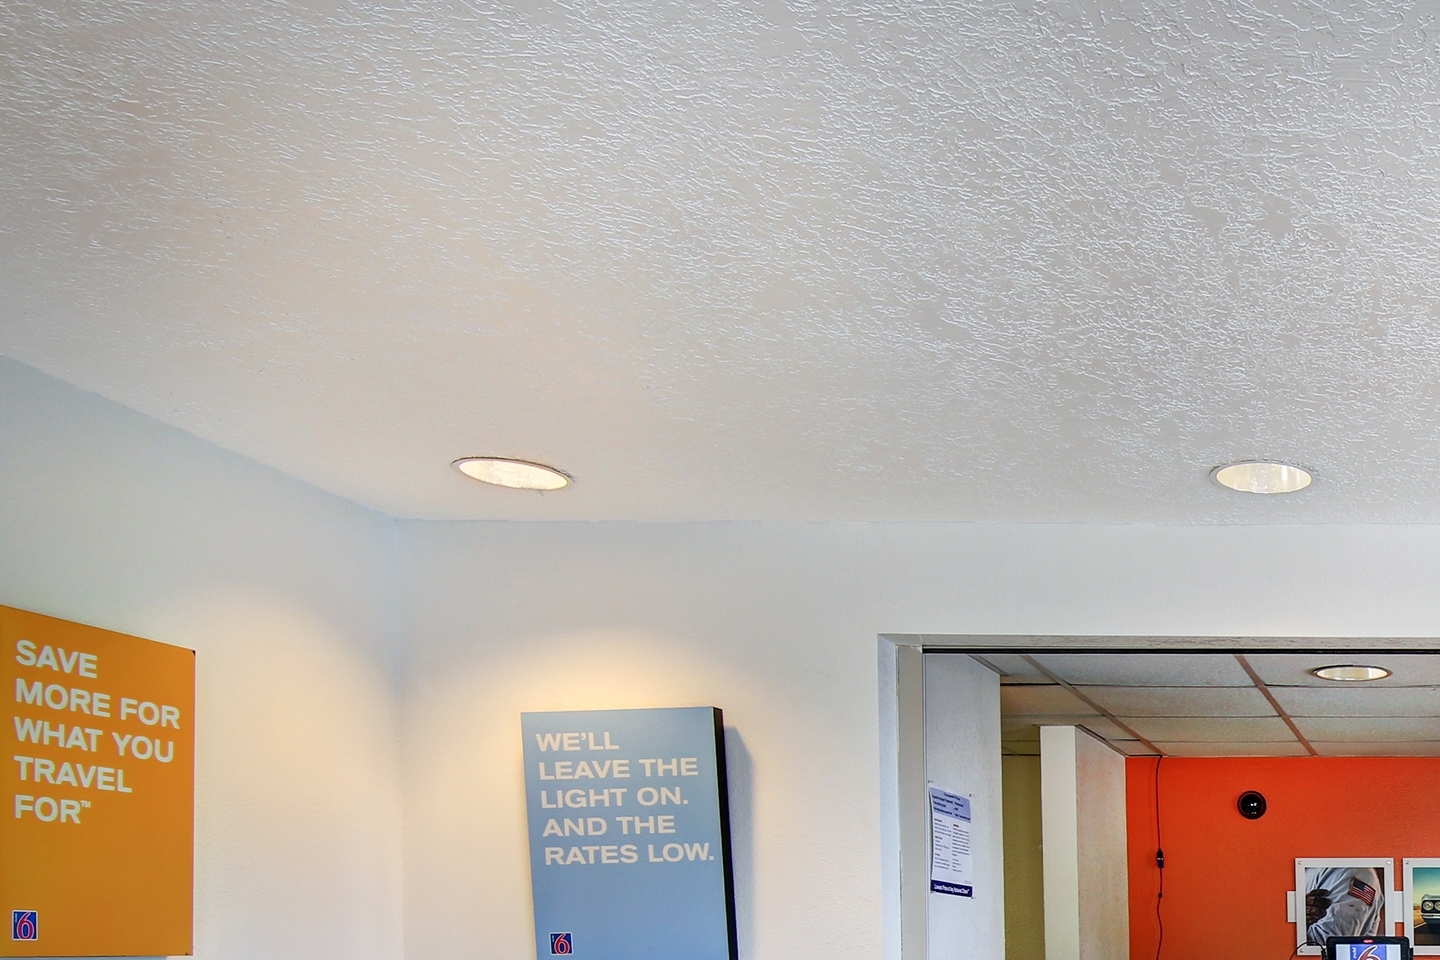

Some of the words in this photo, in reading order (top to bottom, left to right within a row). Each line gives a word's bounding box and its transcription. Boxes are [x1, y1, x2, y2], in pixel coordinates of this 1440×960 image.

[15, 639, 98, 679] SAVE
[15, 678, 111, 718] MORE
[120, 697, 180, 730] FOR
[14, 716, 103, 752] WHAT
[112, 732, 174, 763] YOU
[535, 731, 620, 752] WE'LL
[13, 755, 133, 793] TRAVEL
[538, 759, 631, 781] LEAVE
[638, 757, 699, 777] THE
[541, 788, 628, 809] LIGHT
[636, 786, 689, 807] ON.
[542, 817, 607, 837] AND
[615, 815, 676, 835] THE
[545, 844, 638, 866] RATES
[648, 842, 715, 862] LOW.
[16, 911, 35, 940] 6
[554, 932, 570, 955] 6
